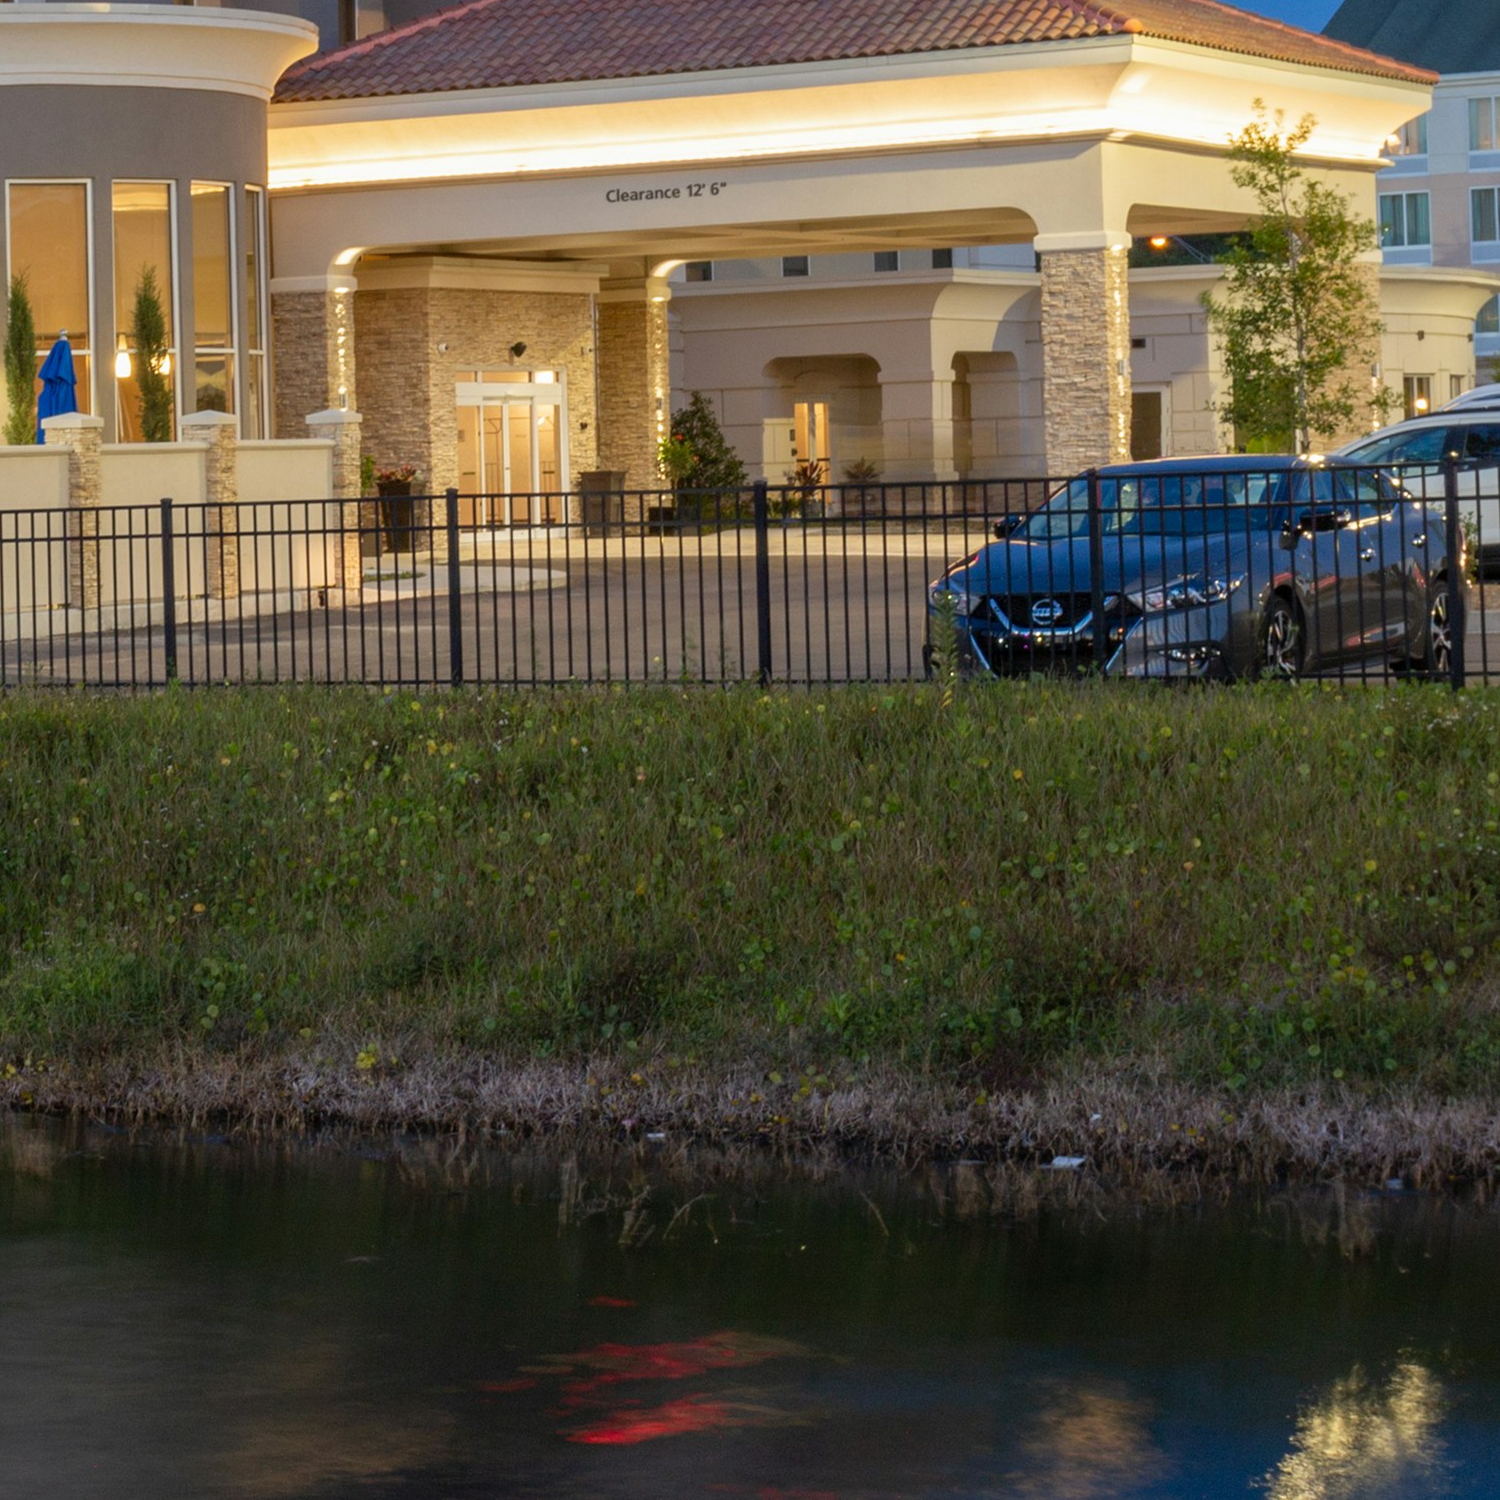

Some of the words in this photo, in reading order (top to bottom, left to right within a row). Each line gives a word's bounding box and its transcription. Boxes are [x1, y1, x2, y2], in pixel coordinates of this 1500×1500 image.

[605, 188, 681, 203] Clearance
[686, 183, 706, 198] 12'
[710, 182, 727, 196] 6"
